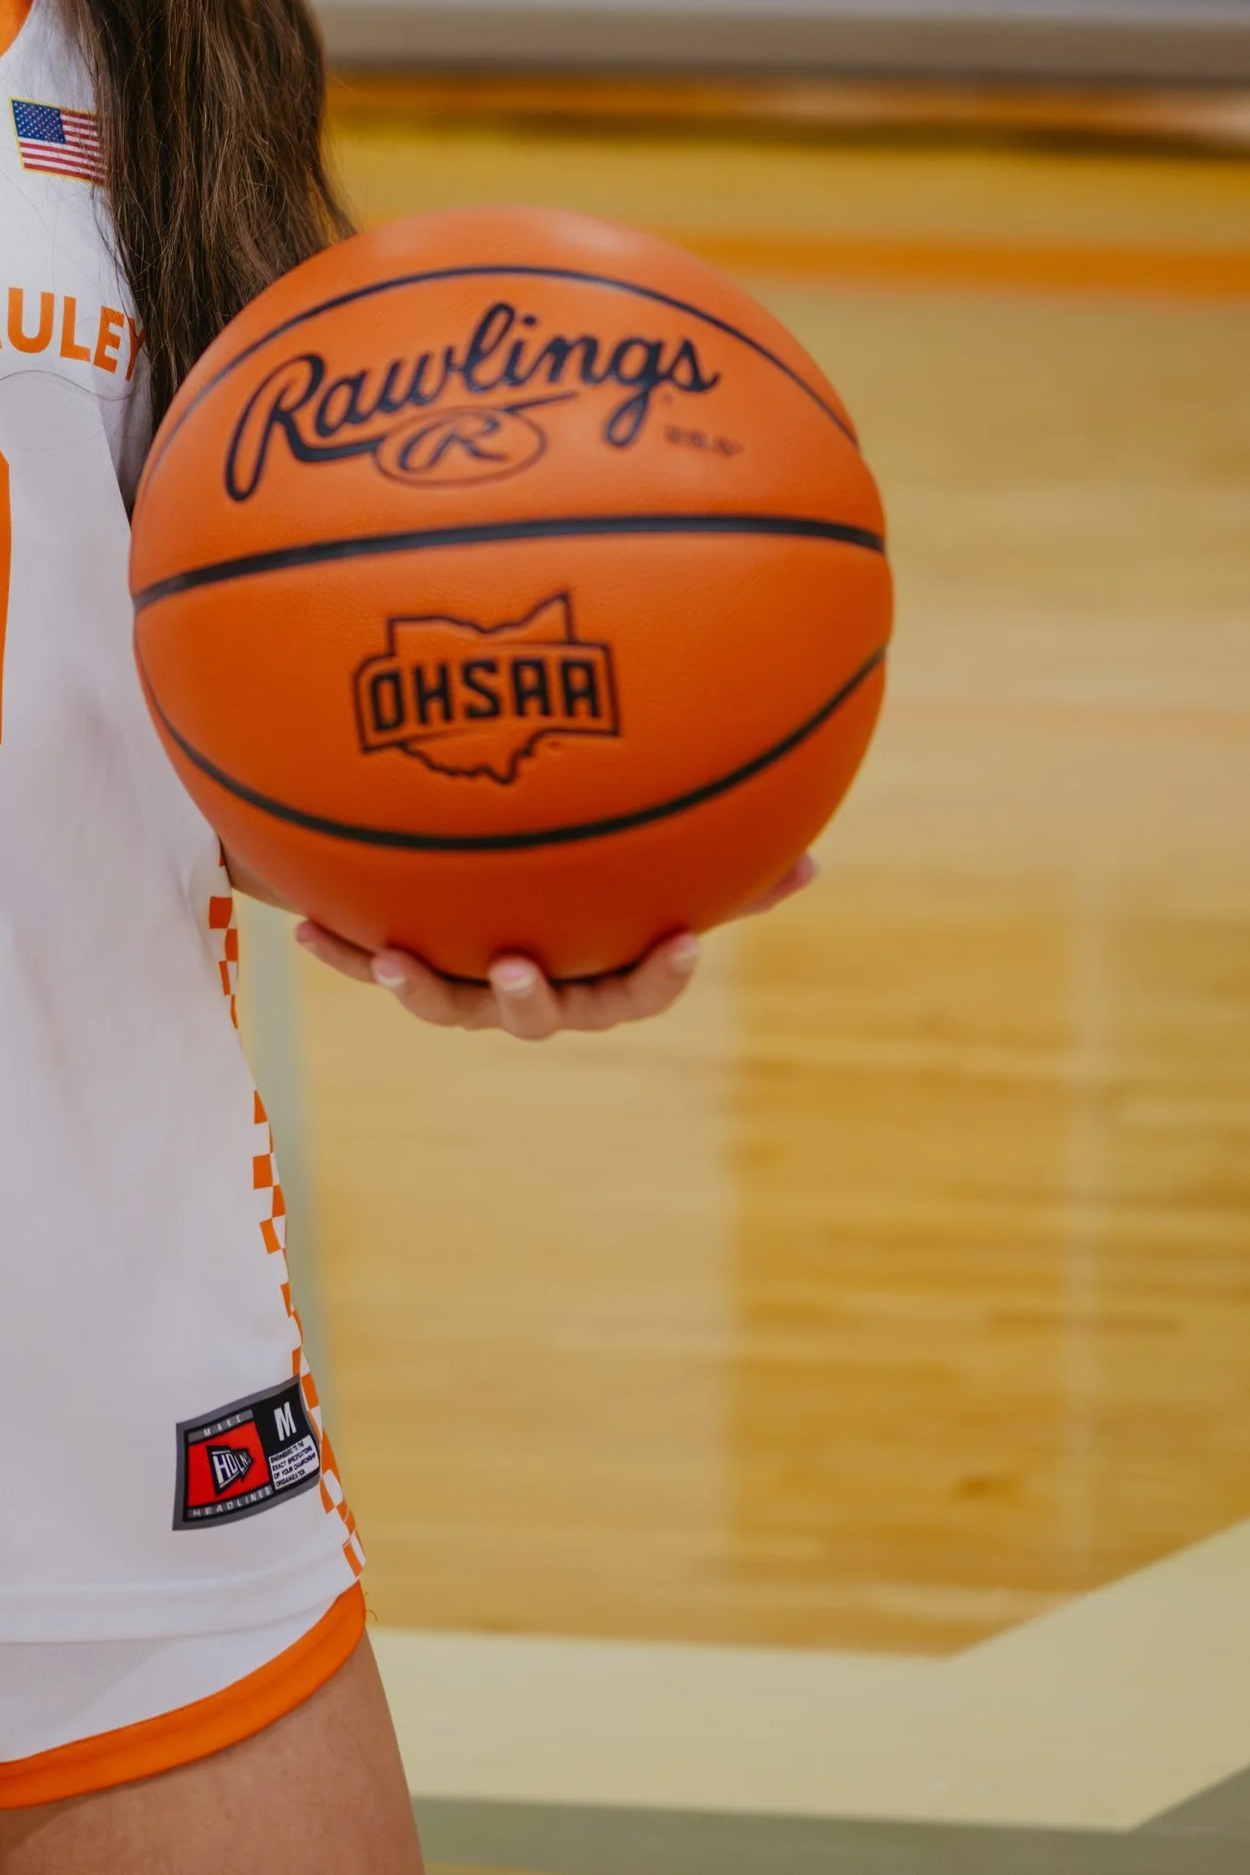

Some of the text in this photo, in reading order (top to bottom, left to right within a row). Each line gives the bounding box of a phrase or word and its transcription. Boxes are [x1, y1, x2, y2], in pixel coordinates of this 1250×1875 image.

[224, 300, 721, 503] Rawlings
[369, 658, 602, 732] OHSAA
[273, 1401, 297, 1442] M
